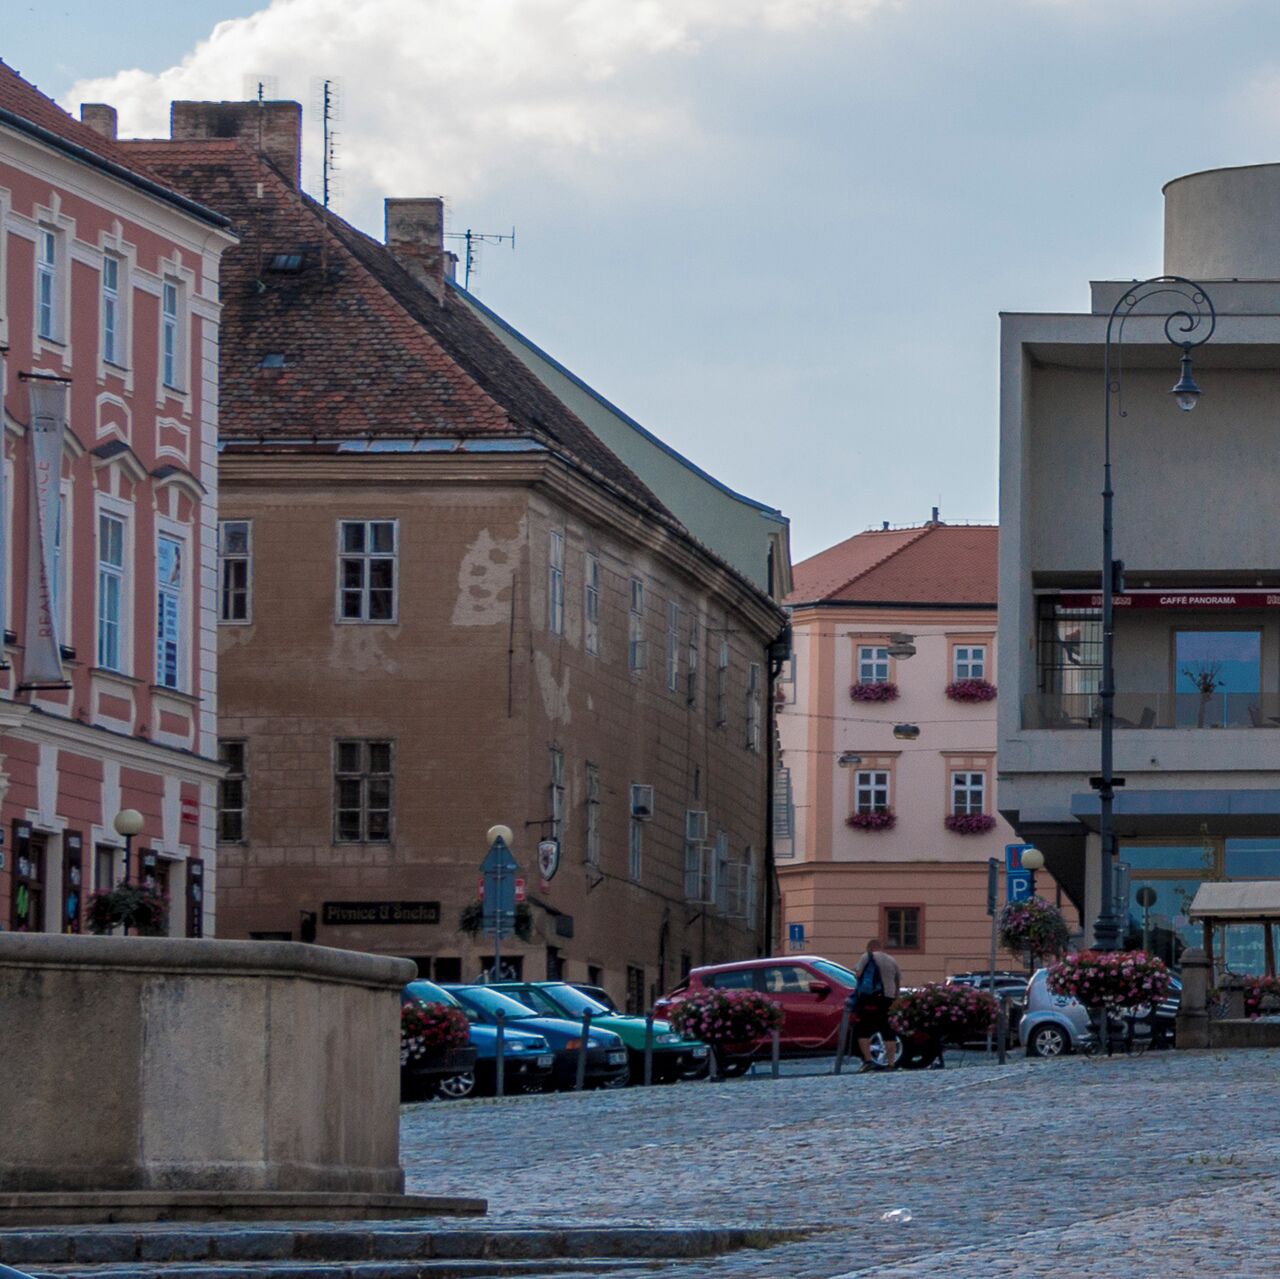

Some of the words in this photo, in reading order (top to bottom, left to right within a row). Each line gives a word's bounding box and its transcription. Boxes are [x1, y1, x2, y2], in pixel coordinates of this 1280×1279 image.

[1160, 595, 1187, 605] CAFFÉ
[1189, 596, 1236, 605] PANORAMA
[1012, 878, 1028, 899] P
[327, 905, 376, 920] Pivnice
